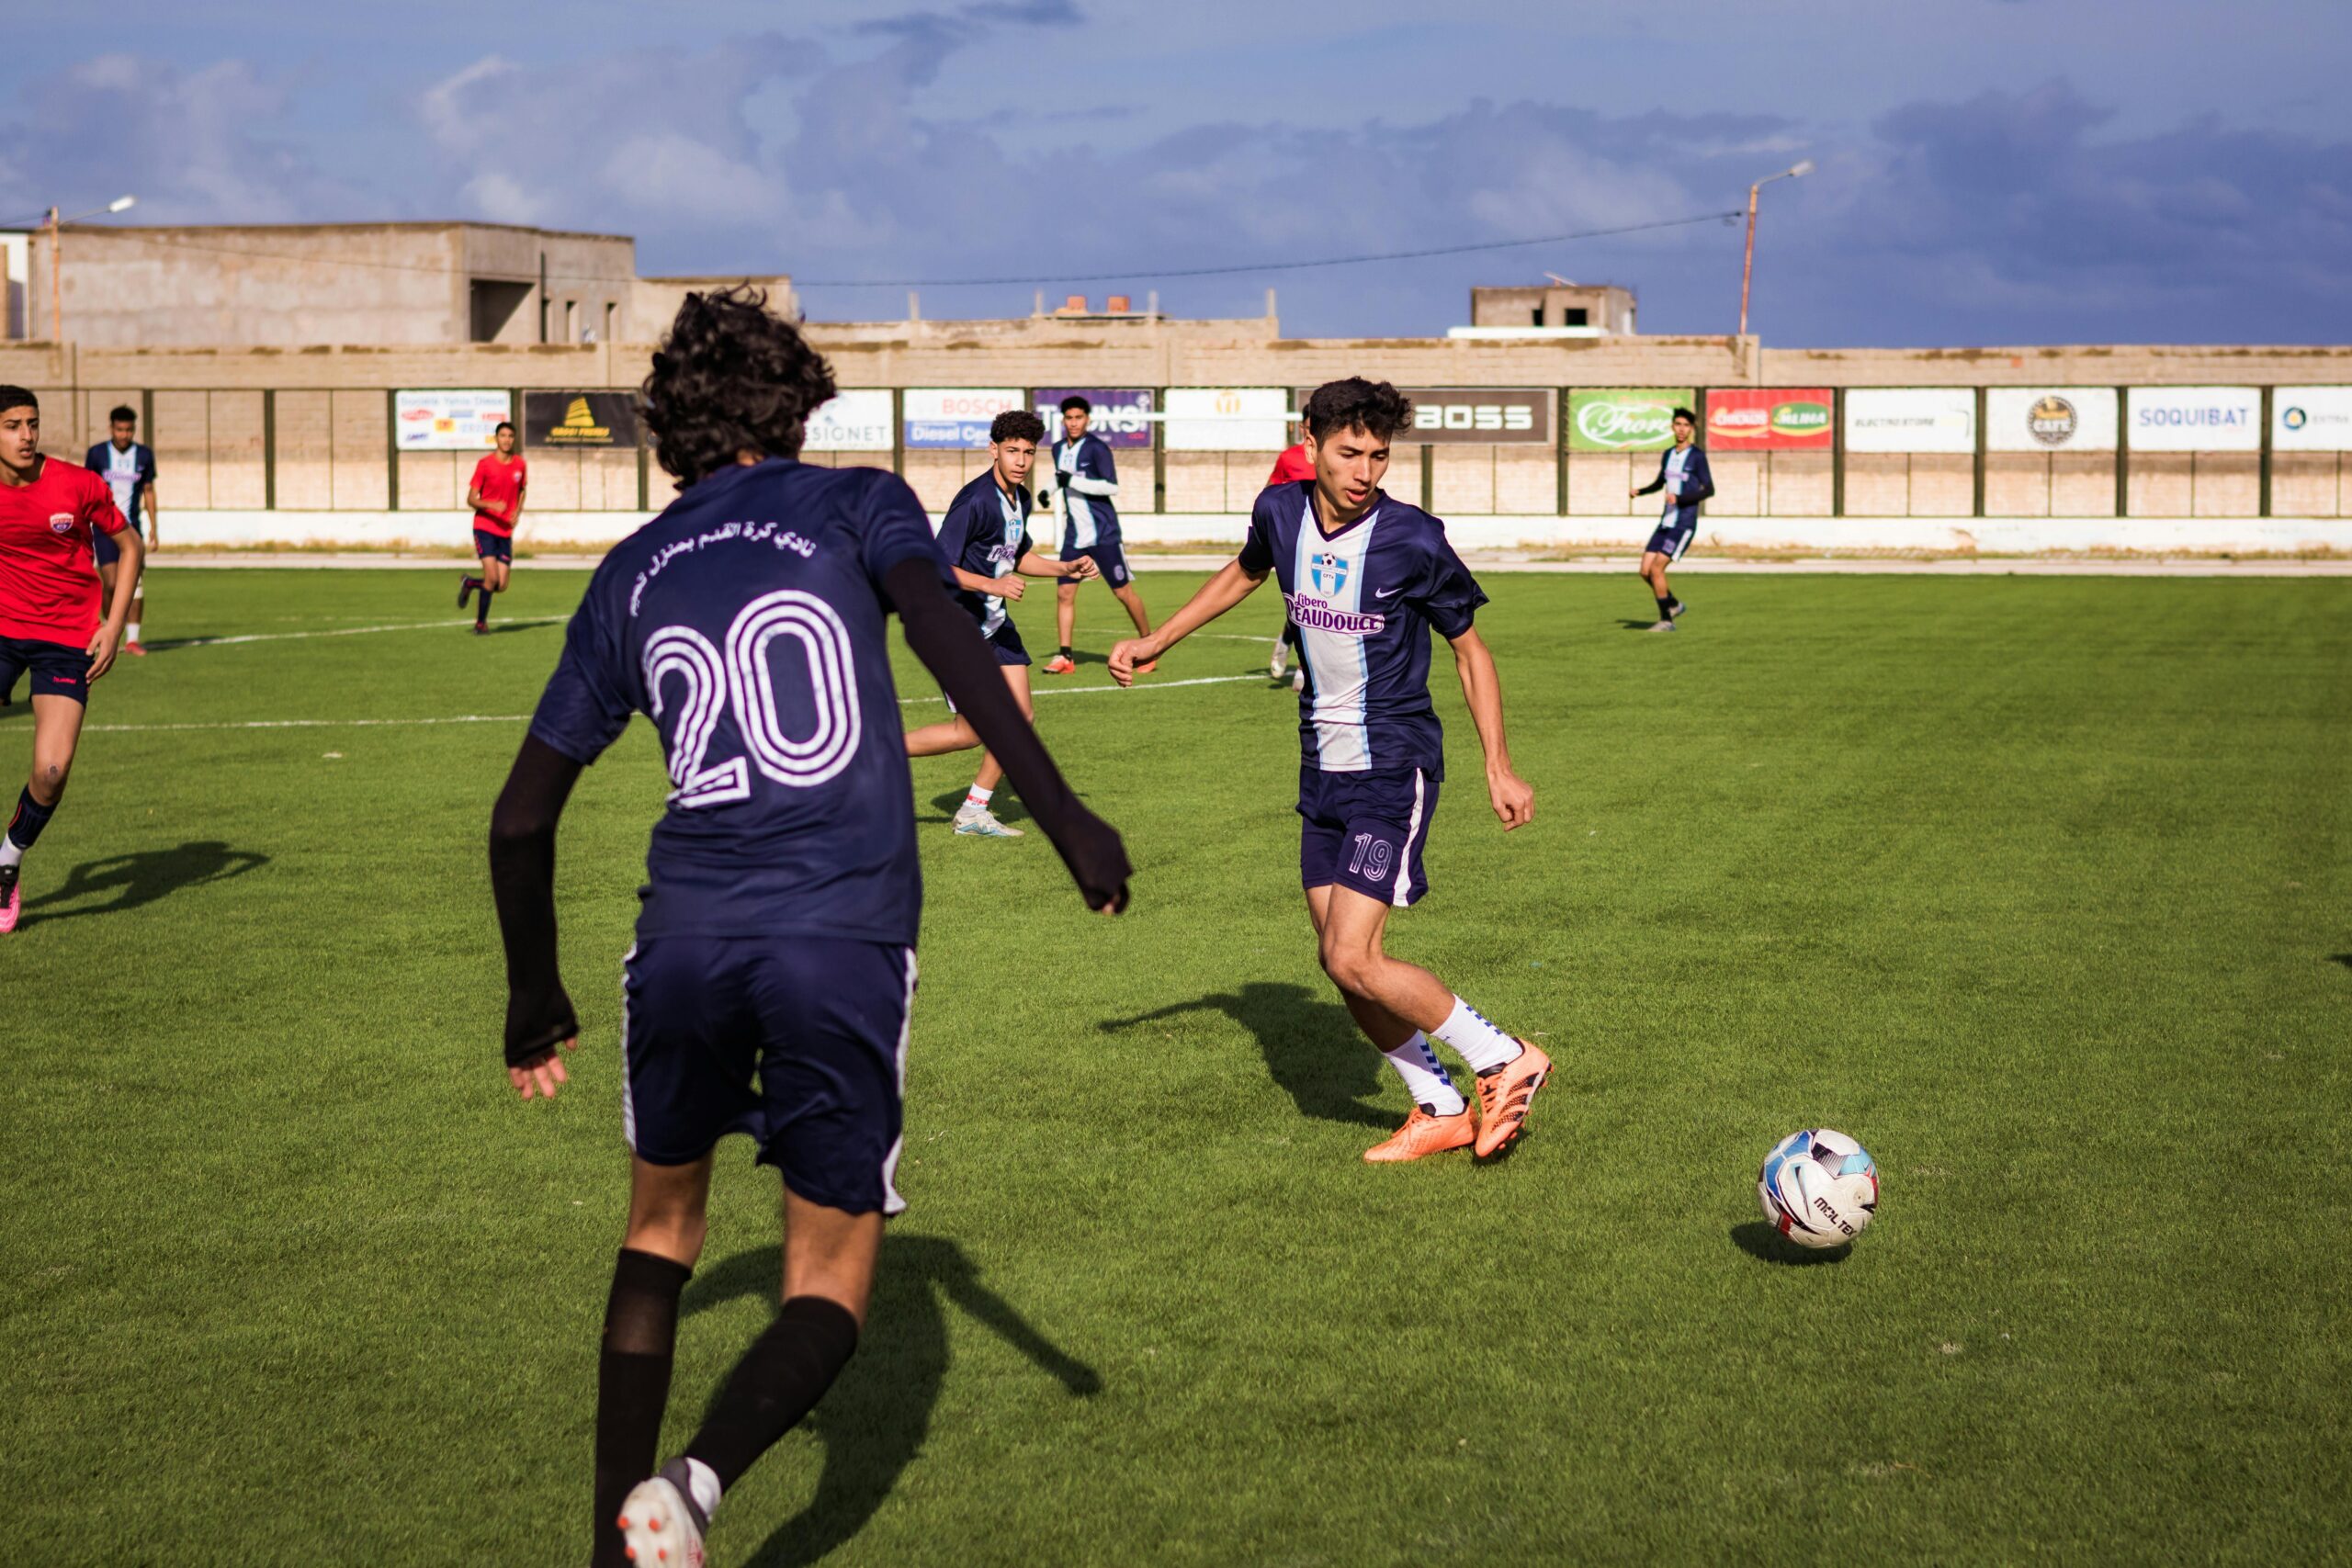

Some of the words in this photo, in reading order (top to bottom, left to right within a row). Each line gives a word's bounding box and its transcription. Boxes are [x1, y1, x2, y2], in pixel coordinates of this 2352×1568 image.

[942, 398, 1012, 415] BOSCH
[2139, 408, 2249, 427] SOQUIBAT
[805, 425, 887, 442] SIGNET
[1295, 592, 1329, 610] Libero
[644, 589, 862, 808] 20
[1349, 832, 1393, 882] 19
